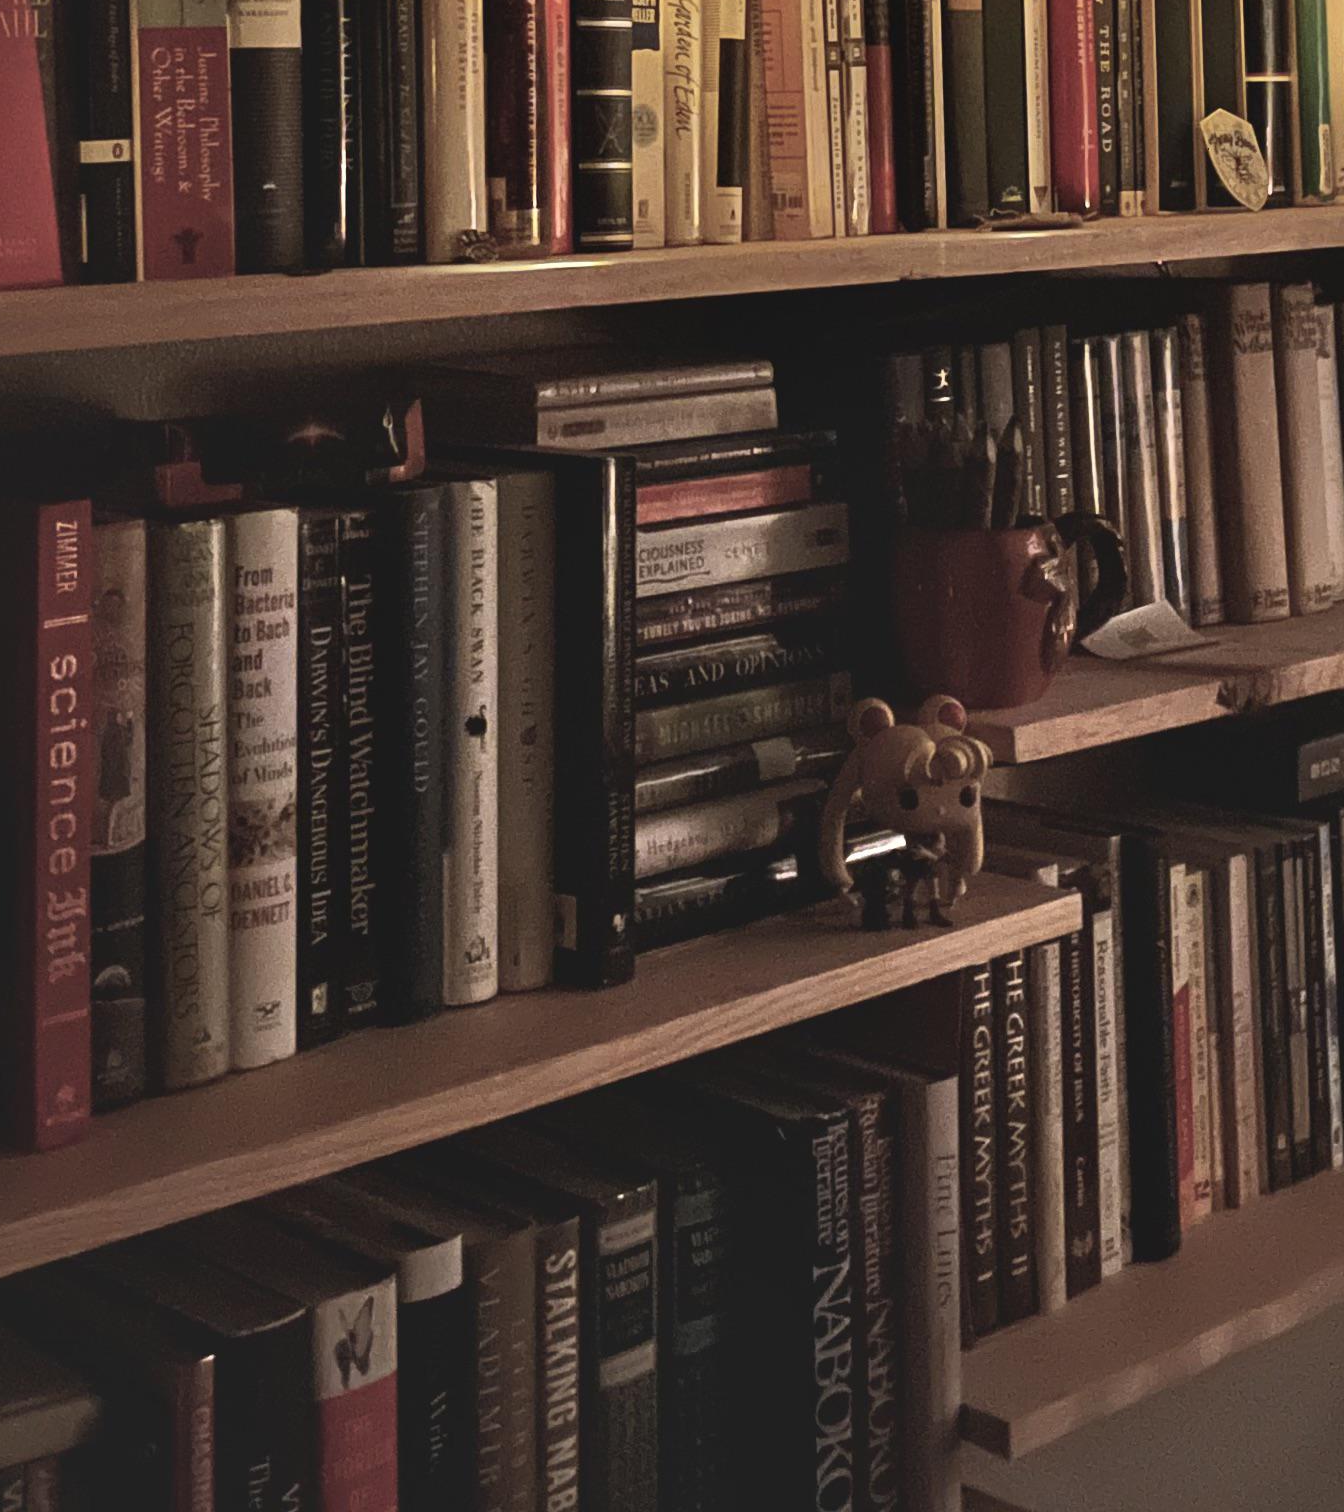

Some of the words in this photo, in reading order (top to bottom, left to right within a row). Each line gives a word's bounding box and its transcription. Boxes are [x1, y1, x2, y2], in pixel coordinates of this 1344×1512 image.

[152, 46, 174, 100] Other
[668, 63, 695, 85] of
[1099, 24, 1112, 74] THE
[674, 84, 700, 141] Eden
[1100, 85, 1113, 154] ROAD
[469, 494, 485, 536] THE
[55, 519, 79, 595] ZIMMER
[235, 564, 273, 588] From
[413, 510, 429, 631] STEPHEN
[469, 547, 485, 618] BLACK
[638, 555, 705, 580] EXPLAINED
[234, 620, 252, 643] to
[255, 617, 291, 640] Bach
[235, 590, 295, 616] Bacteria
[347, 575, 376, 637] The
[235, 649, 264, 672] and
[309, 625, 334, 744] DARWIN'S
[347, 643, 376, 725] Blind
[413, 641, 430, 683] JAY
[469, 626, 485, 687] SWAN
[686, 661, 725, 689] AND
[734, 644, 824, 678] OPINIONS
[234, 676, 272, 700] Back
[168, 622, 196, 820] FORGOTTEN
[236, 711, 264, 730] The
[414, 696, 430, 795] GOULD
[48, 653, 78, 876] science
[252, 760, 293, 784] Minds
[309, 747, 335, 884] DANGEROUS
[349, 731, 377, 935] Watchmaker
[231, 877, 279, 907] DANIEL
[231, 900, 290, 932] DENNETT
[310, 885, 334, 946] IDEA
[42, 886, 90, 985] Ink
[171, 834, 197, 1020] ANCESTORS
[1095, 938, 1112, 1049] Reasonable
[974, 1025, 992, 1128] GREEK
[1006, 1012, 1026, 1113] GREEK
[1098, 1052, 1112, 1105] Faith
[813, 1135, 835, 1249] Literature
[828, 1118, 850, 1216] Lectures
[973, 1136, 993, 1256] MYTHS
[1007, 1120, 1027, 1239] MYTHS
[829, 1217, 850, 1254] on
[545, 1247, 577, 1430] STALKING
